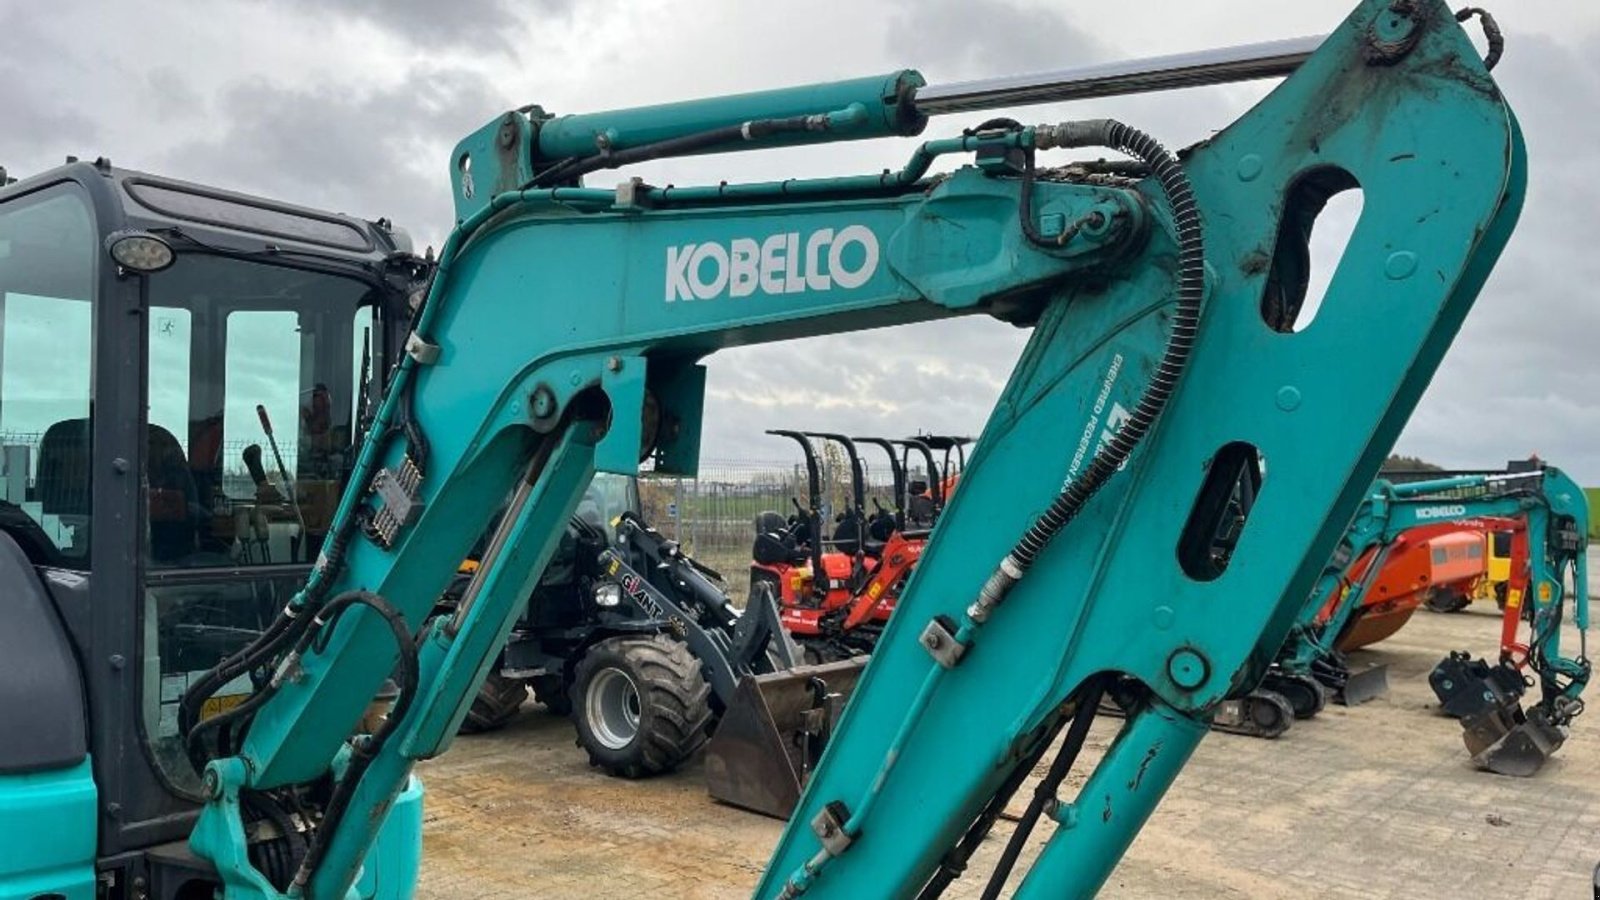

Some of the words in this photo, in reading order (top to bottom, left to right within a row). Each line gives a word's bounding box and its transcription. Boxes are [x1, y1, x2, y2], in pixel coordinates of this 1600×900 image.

[665, 225, 880, 303] KOBELCO
[1069, 415, 1098, 476] PEDERSEN
[1415, 505, 1466, 519] KOBELCO
[622, 574, 664, 620] GIANT
